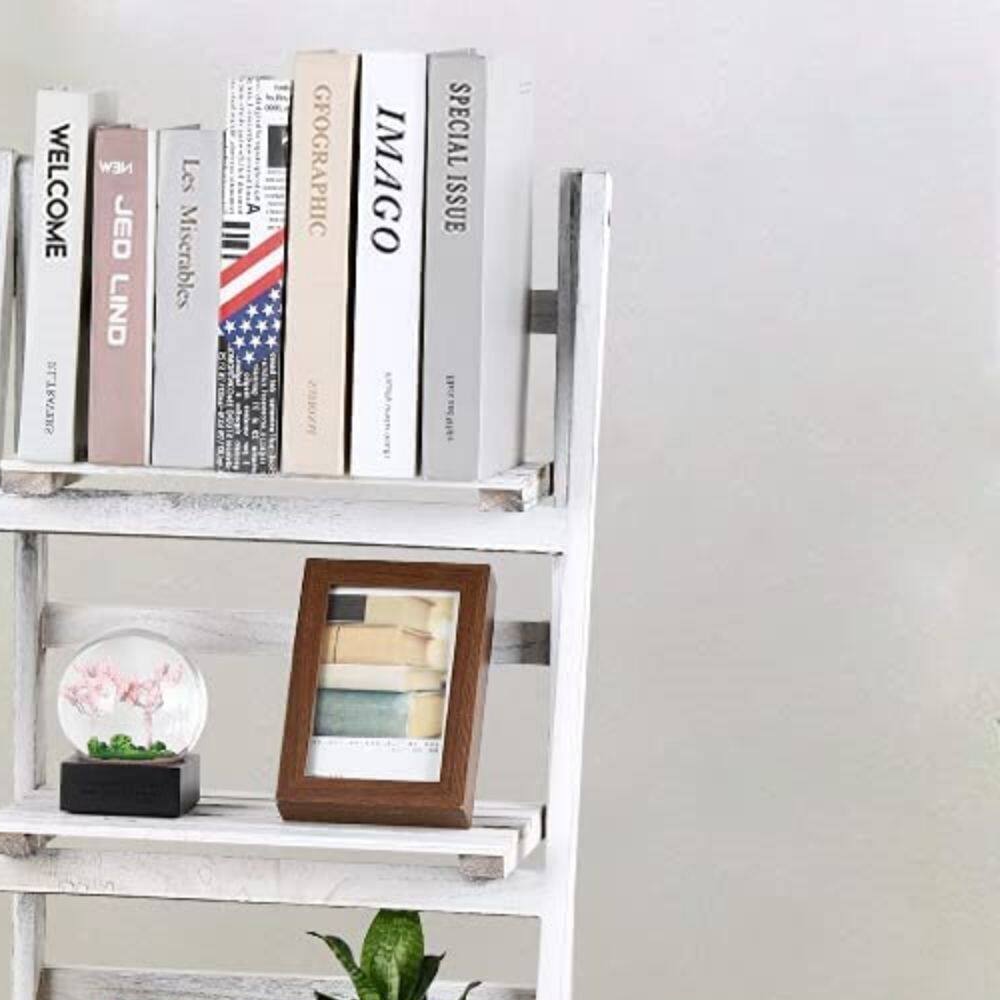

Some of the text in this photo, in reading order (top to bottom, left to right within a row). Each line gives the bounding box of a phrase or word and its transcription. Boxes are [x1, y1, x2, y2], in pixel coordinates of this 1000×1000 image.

[45, 123, 71, 259] WELCOME
[180, 158, 200, 193] Les
[371, 105, 407, 255] IMAGO
[443, 82, 472, 233] SPECIAL ISSUE
[107, 195, 134, 347] JED LIND
